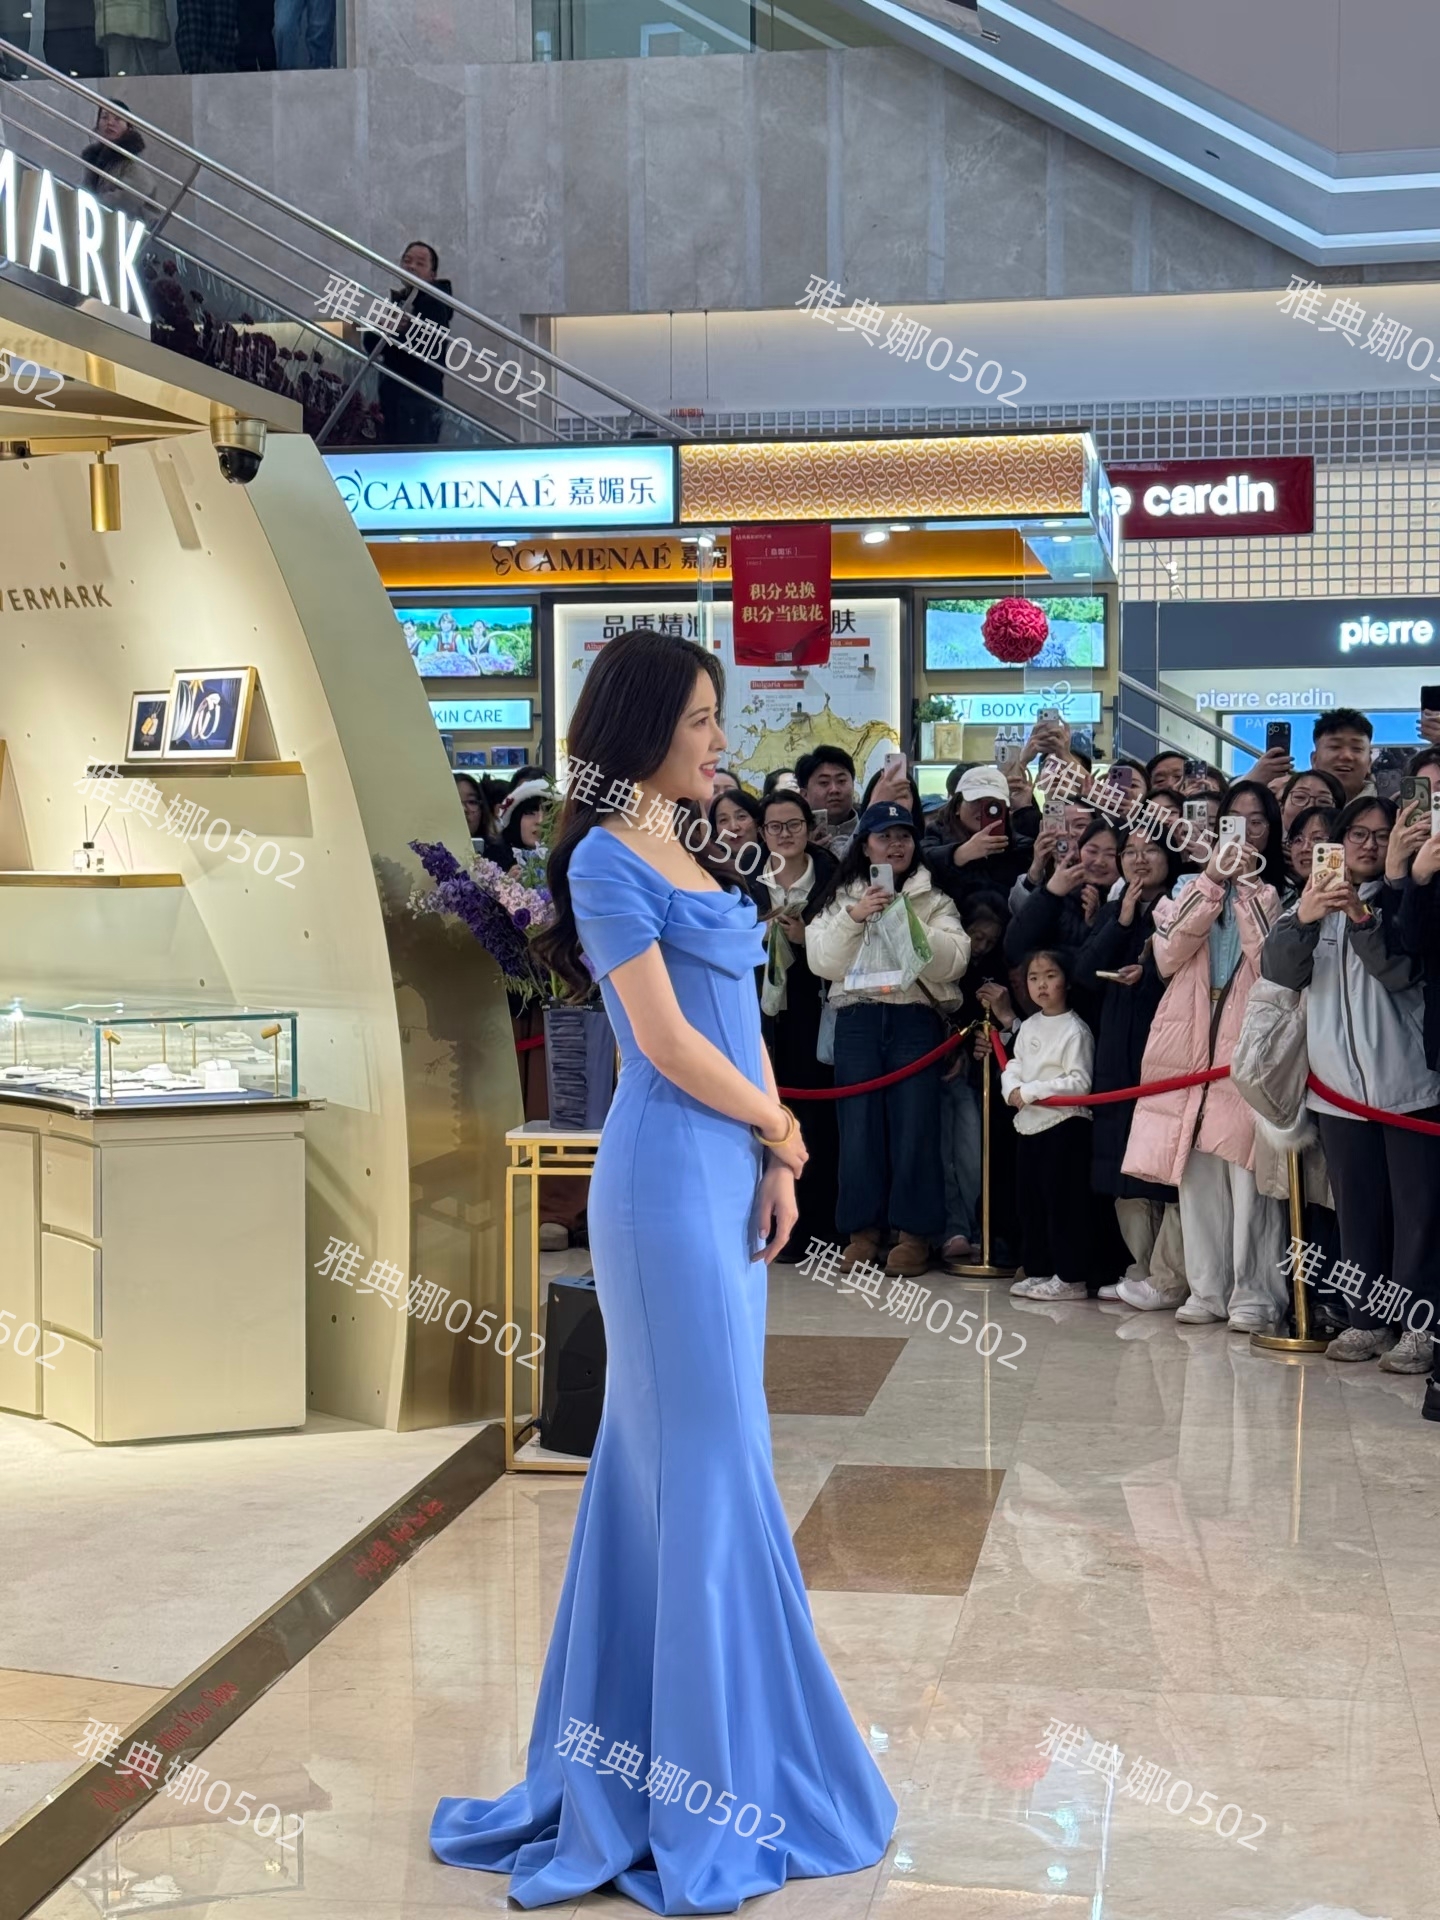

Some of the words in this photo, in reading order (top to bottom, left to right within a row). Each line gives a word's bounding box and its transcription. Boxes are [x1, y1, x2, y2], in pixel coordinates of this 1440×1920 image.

[363, 474, 556, 511] CAMENAÉ
[568, 476, 657, 506] 嘉媚乐
[1143, 475, 1275, 516] cardin
[514, 543, 672, 573] CAMENAÉ
[0, 584, 112, 612] ERMARK
[750, 581, 816, 600] 积分兑换
[741, 604, 824, 623] 积分当钱花
[1340, 615, 1434, 652] pierre
[981, 703, 1025, 717] BODY
[1196, 688, 1259, 712] pierre
[1266, 688, 1335, 707] cardin
[463, 709, 503, 723] CARE
[889, 806, 899, 817] R
[154, 1719, 193, 1752] Mind
[177, 1704, 214, 1727] Your
[200, 1681, 240, 1709] Steps
